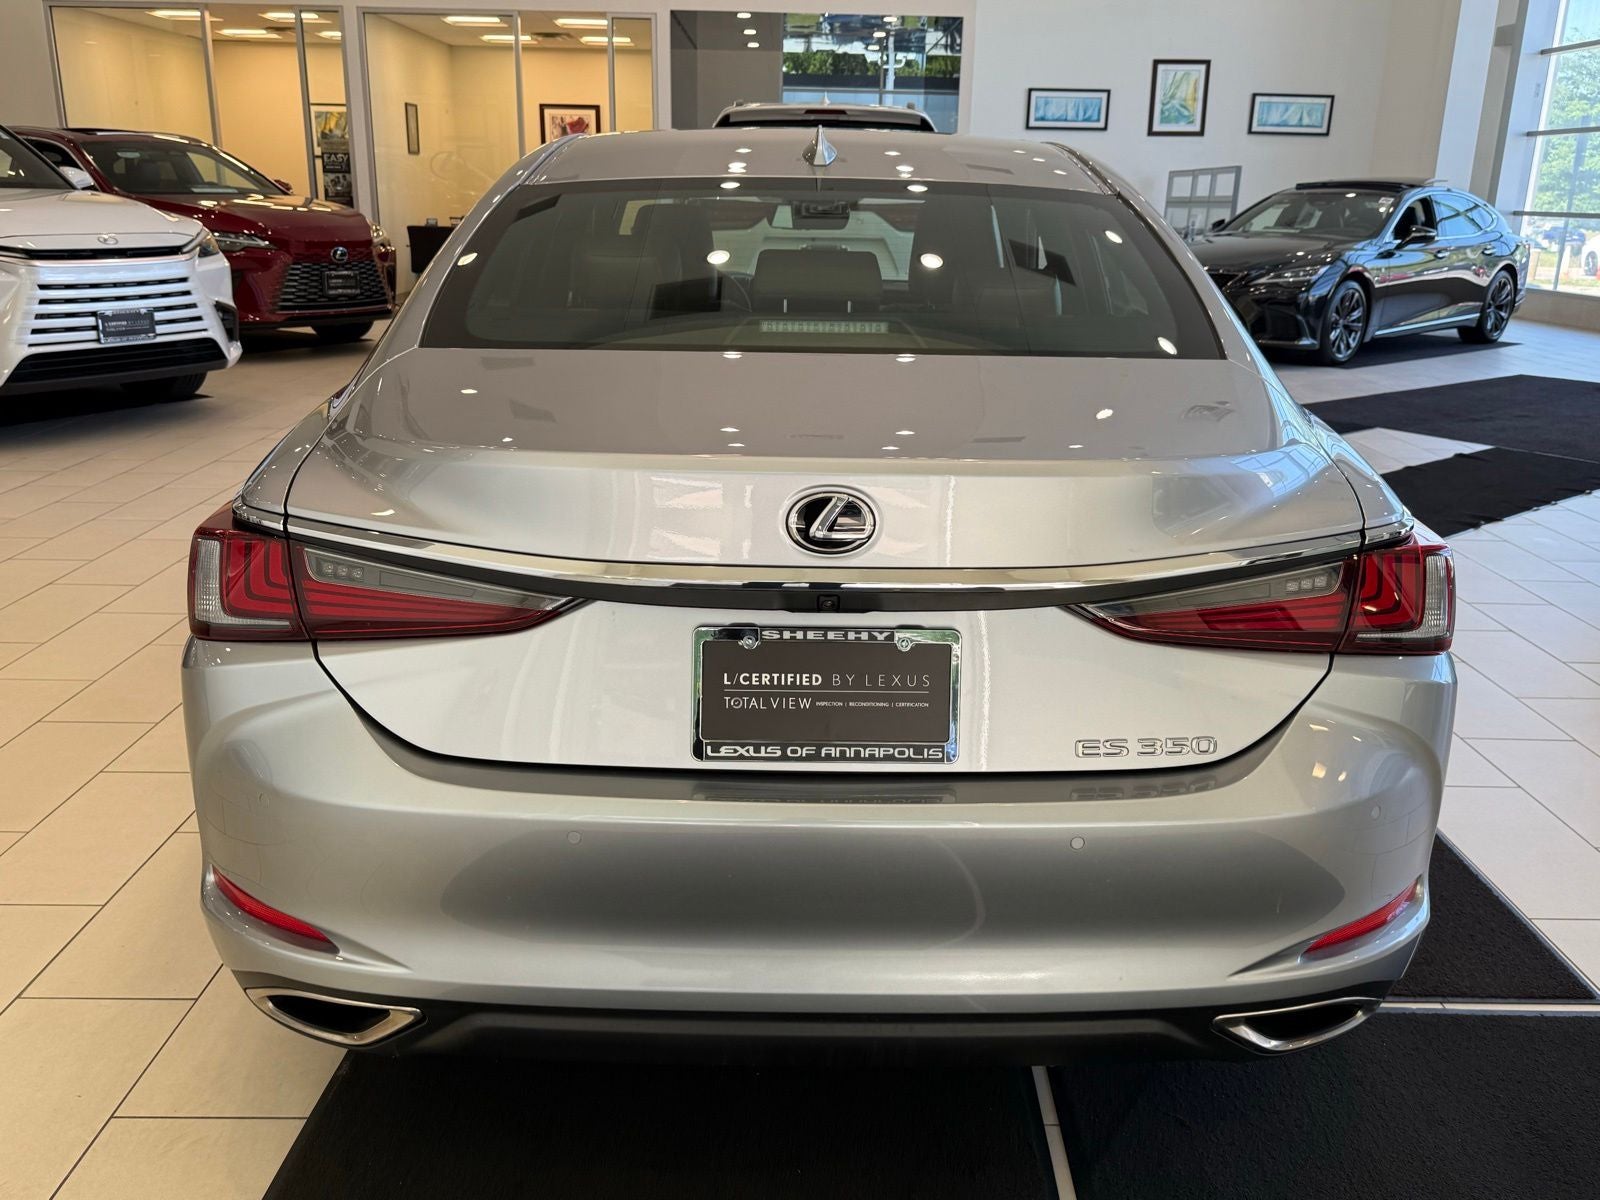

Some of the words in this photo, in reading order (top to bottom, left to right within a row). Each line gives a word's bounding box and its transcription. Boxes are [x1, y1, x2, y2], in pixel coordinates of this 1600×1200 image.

[761, 630, 892, 640] SHEEHY
[723, 672, 823, 686] L/CERTIFIED
[832, 673, 855, 687] BY
[865, 673, 930, 688] LEXUS
[723, 696, 767, 710] TOTAL
[770, 696, 812, 710] VIEW
[706, 745, 782, 757] LEXUS
[786, 745, 817, 758] OF
[821, 746, 943, 760] ANNAPOLIS
[1075, 738, 1130, 759] ES
[1137, 735, 1218, 757] 350
